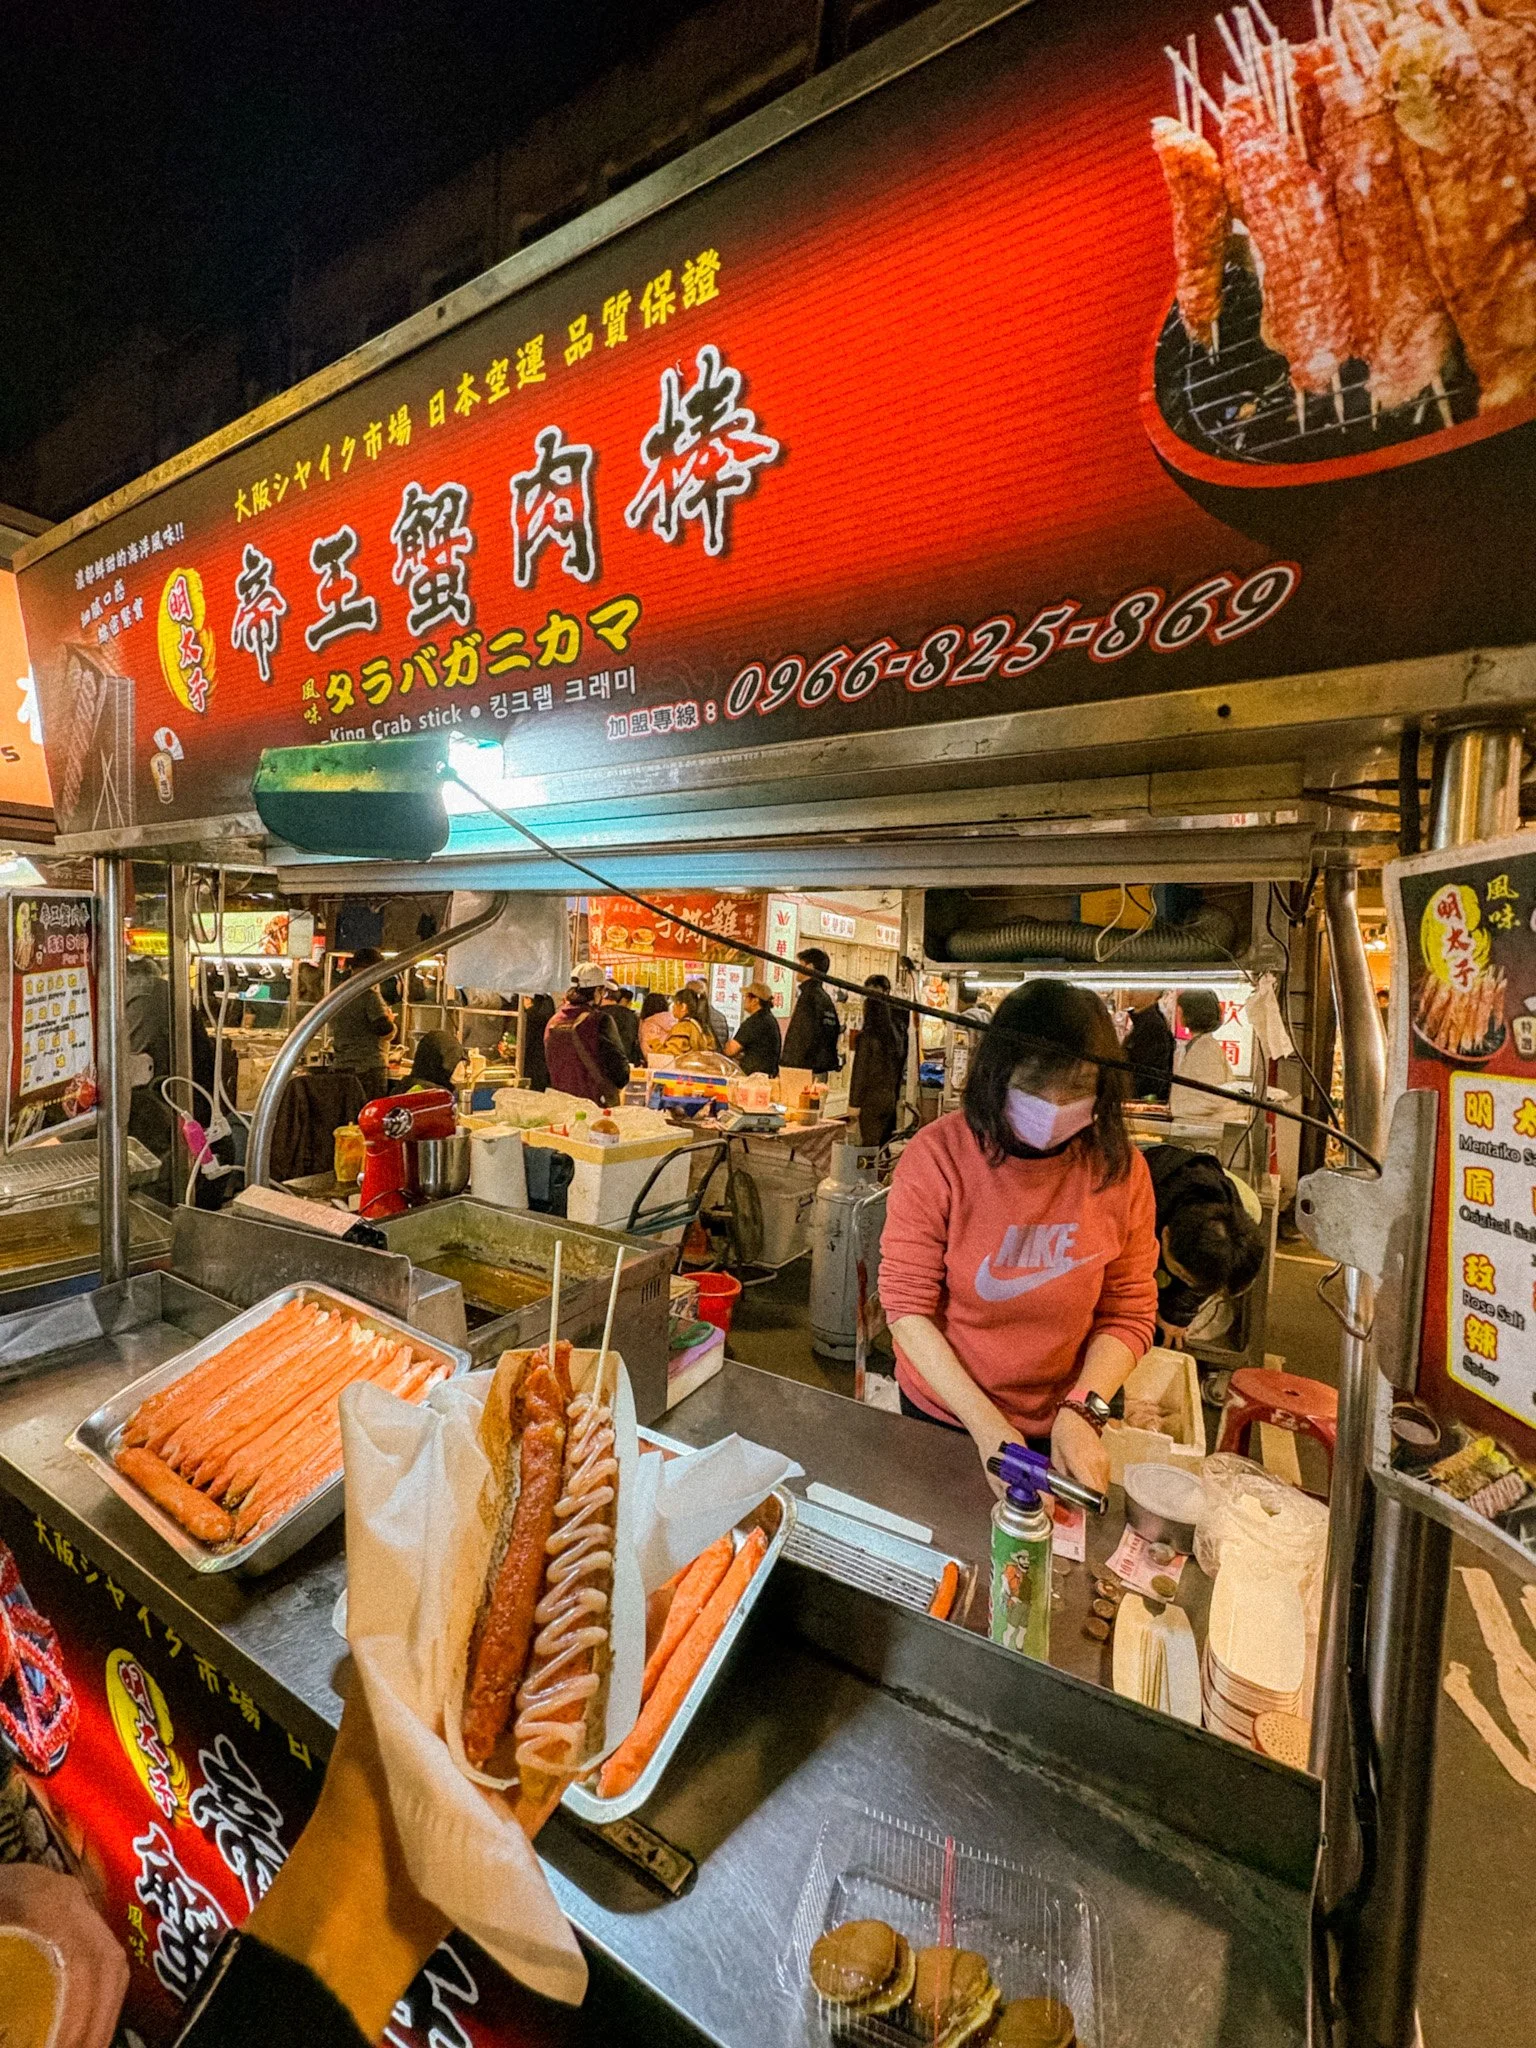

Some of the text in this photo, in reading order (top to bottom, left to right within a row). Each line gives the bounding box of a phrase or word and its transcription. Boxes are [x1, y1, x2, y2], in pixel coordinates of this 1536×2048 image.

[428, 333, 547, 429] 日本空運
[563, 248, 721, 367] 品質保證
[231, 344, 781, 683] 帝王蟹肉棒
[165, 574, 212, 714] 明太子
[326, 594, 642, 717] タラバガニカマ
[726, 562, 1300, 716] 0966-825-869
[301, 677, 322, 726] 風味
[488, 666, 637, 720] 킹크랩 크래미
[372, 715, 412, 741] Crab
[419, 704, 463, 730] stick
[1486, 874, 1520, 930] 風味
[1437, 891, 1475, 987] 明太子
[1459, 1134, 1522, 1163] Mentaiko
[994, 1222, 1080, 1268] NIKE
[1459, 1205, 1511, 1235] Original
[1462, 1289, 1526, 1331] Rose Salt
